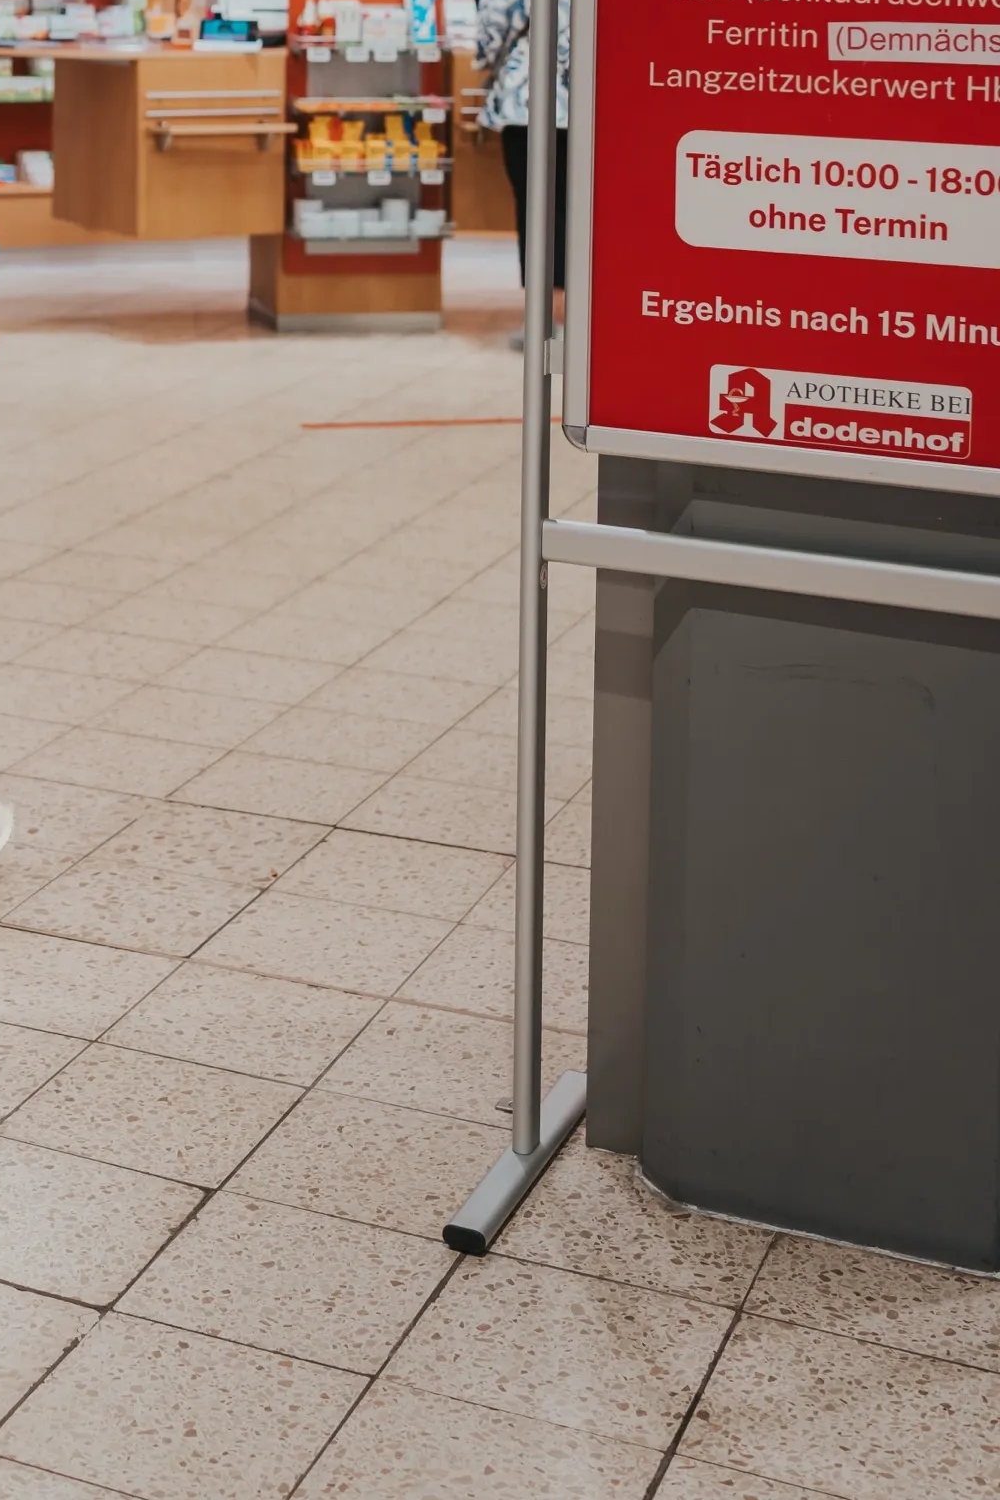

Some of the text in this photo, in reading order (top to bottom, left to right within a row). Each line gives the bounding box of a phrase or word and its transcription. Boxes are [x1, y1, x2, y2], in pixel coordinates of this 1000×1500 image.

[707, 19, 818, 49] Ferritin
[648, 62, 955, 100] Langzeitzuckerwert
[685, 153, 800, 186] Täglich
[810, 160, 899, 190] 10:00
[926, 167, 1000, 196] 18:0
[749, 203, 948, 241] ohne Termin
[642, 290, 781, 326] Ergebnis
[790, 306, 868, 335] nach
[878, 311, 915, 339] 15
[787, 381, 971, 414] APOTHEKE BEI
[790, 417, 965, 453] dodenhof
